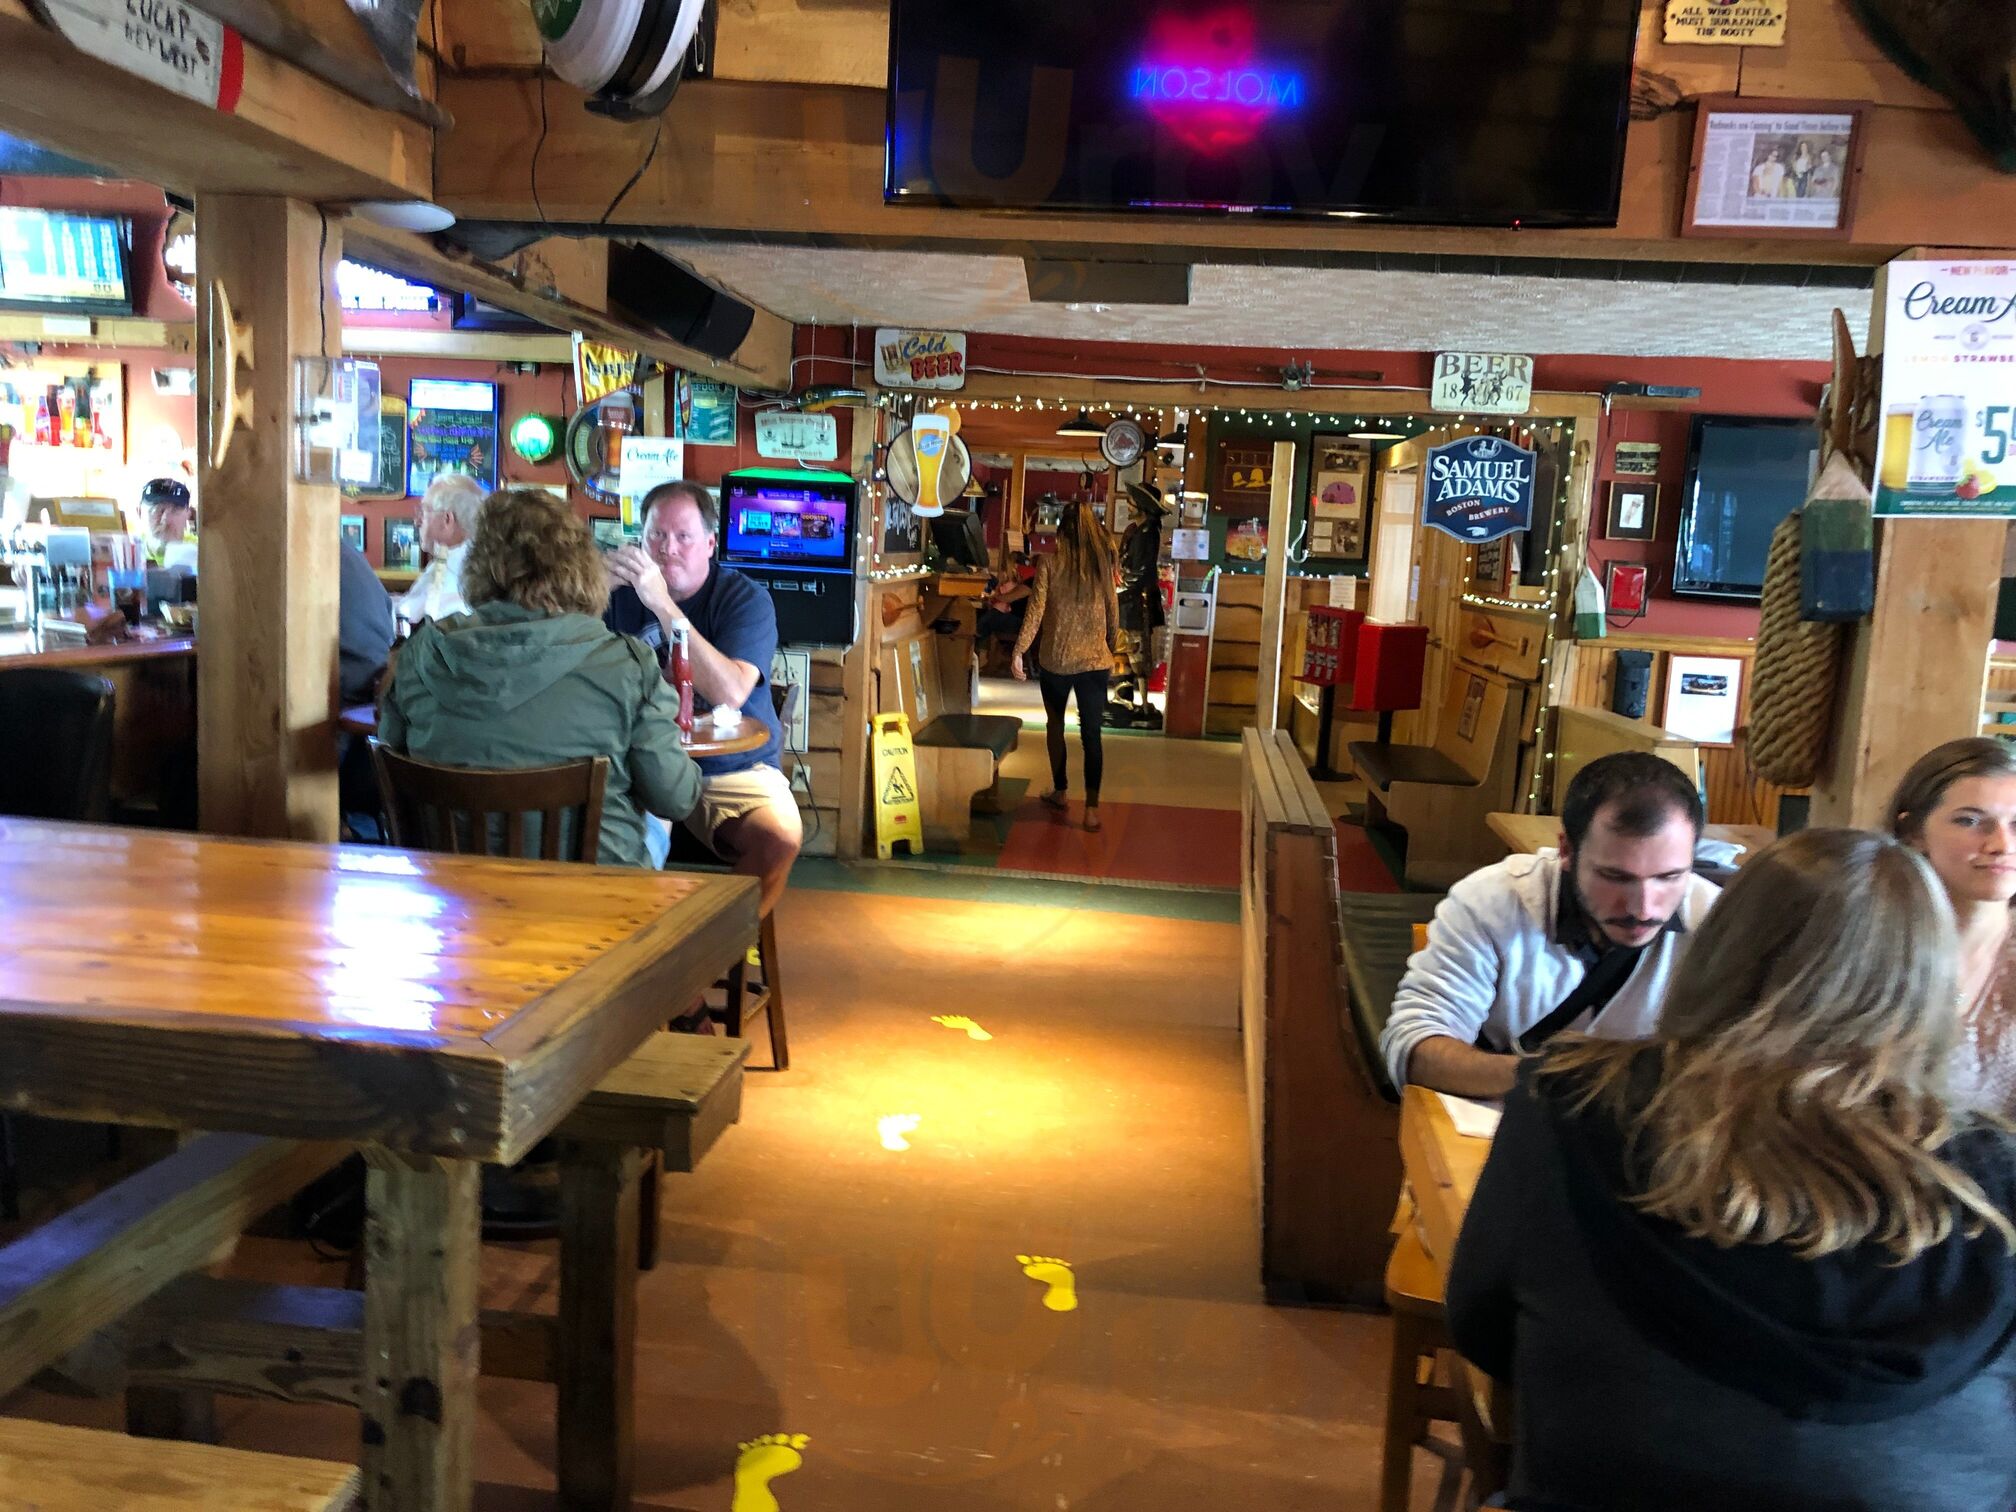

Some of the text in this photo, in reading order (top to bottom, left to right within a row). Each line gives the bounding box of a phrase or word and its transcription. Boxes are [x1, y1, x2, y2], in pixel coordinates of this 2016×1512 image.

[1682, 7, 1771, 16] ALL WHO ENTER
[1676, 17, 1776, 26] MUST SURRENDER
[1696, 28, 1755, 36] THE BOOTY
[1950, 266, 1970, 275] NEW
[1903, 281, 1999, 320] Cream
[903, 336, 947, 359] Cold
[910, 351, 963, 381] BEER
[1439, 354, 1528, 384] BEER
[1442, 383, 1523, 401] 18 67
[1916, 410, 1963, 431] Cream
[1917, 428, 1954, 454] Ale
[626, 447, 679, 466] Cream Ale
[1431, 456, 1530, 484] SAMUEL
[1436, 478, 1522, 503] ADAMS
[1446, 499, 1481, 517] BOSTON
[1468, 507, 1511, 521] BREWERY
[882, 747, 908, 756] CAUTION
